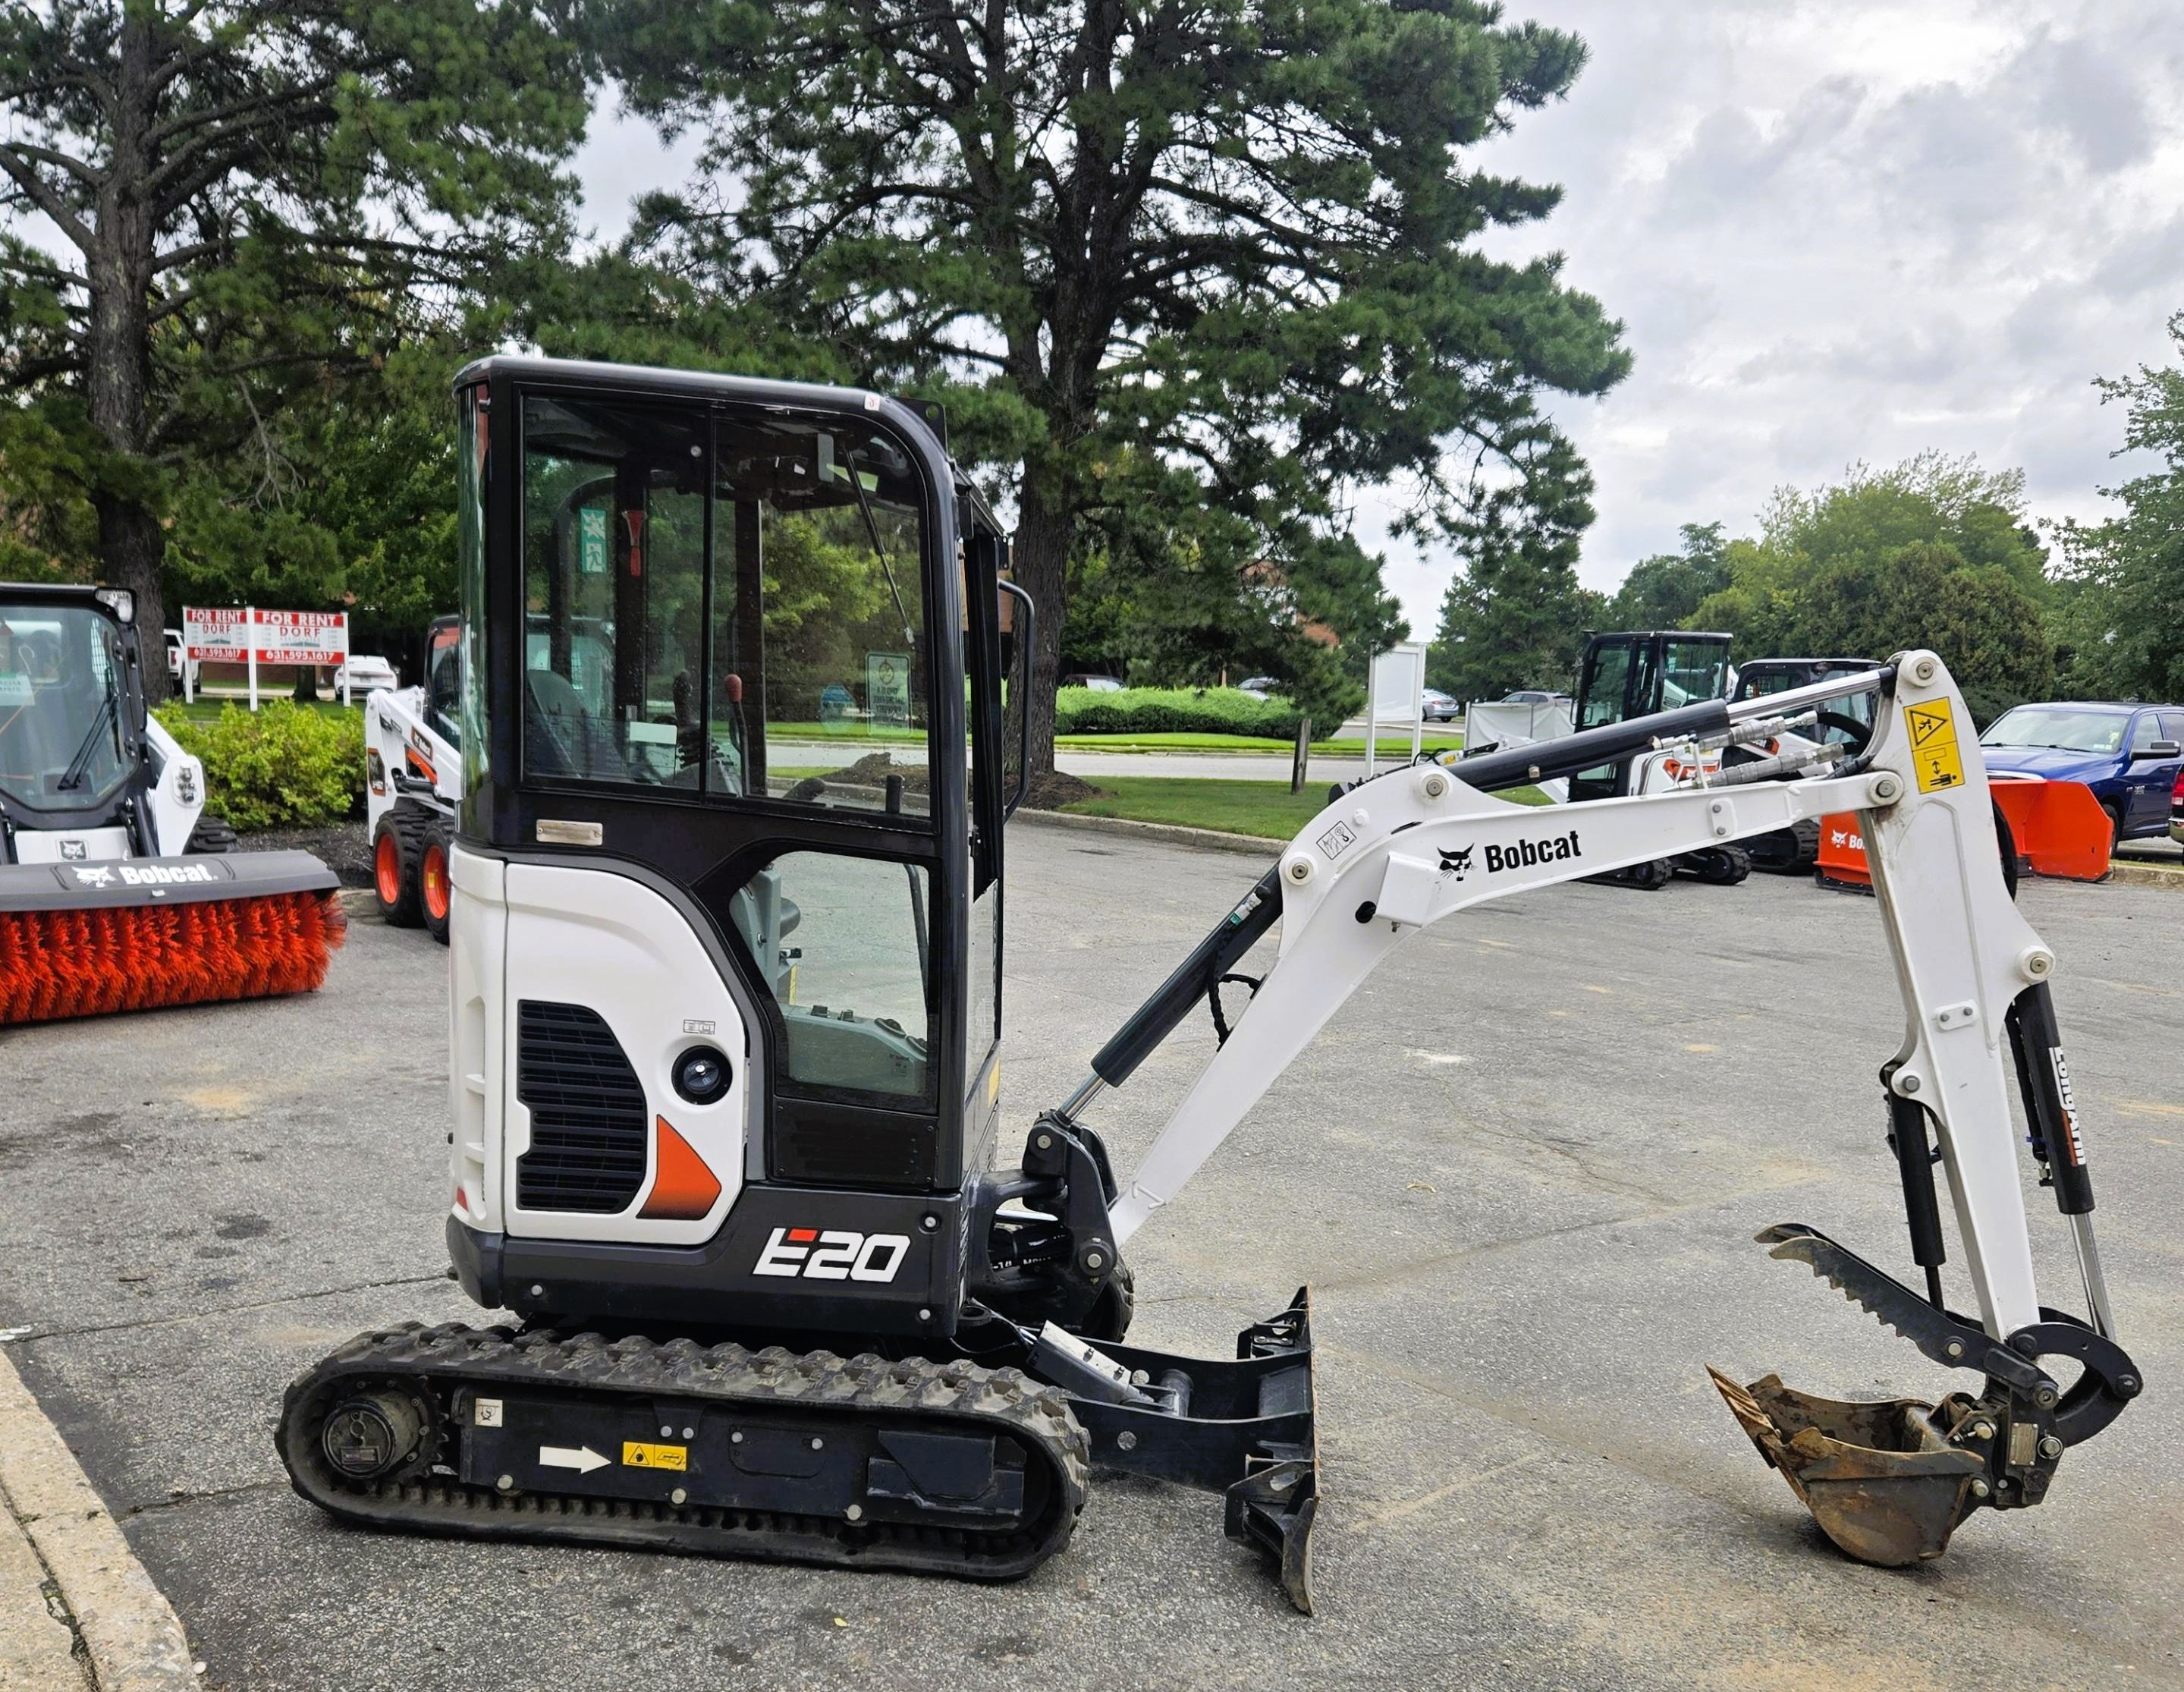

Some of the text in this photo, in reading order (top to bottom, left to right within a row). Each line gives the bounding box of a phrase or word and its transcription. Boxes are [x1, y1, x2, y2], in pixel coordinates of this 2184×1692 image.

[191, 610, 242, 623] FOR RENT
[262, 612, 336, 627] FOR RENT
[203, 624, 231, 634] DORF
[279, 627, 321, 637] DORF
[266, 650, 335, 661] 631.595.1617
[1484, 830, 1582, 873] Bobcat
[118, 863, 213, 885] Bobcat
[753, 1228, 911, 1283] E20
